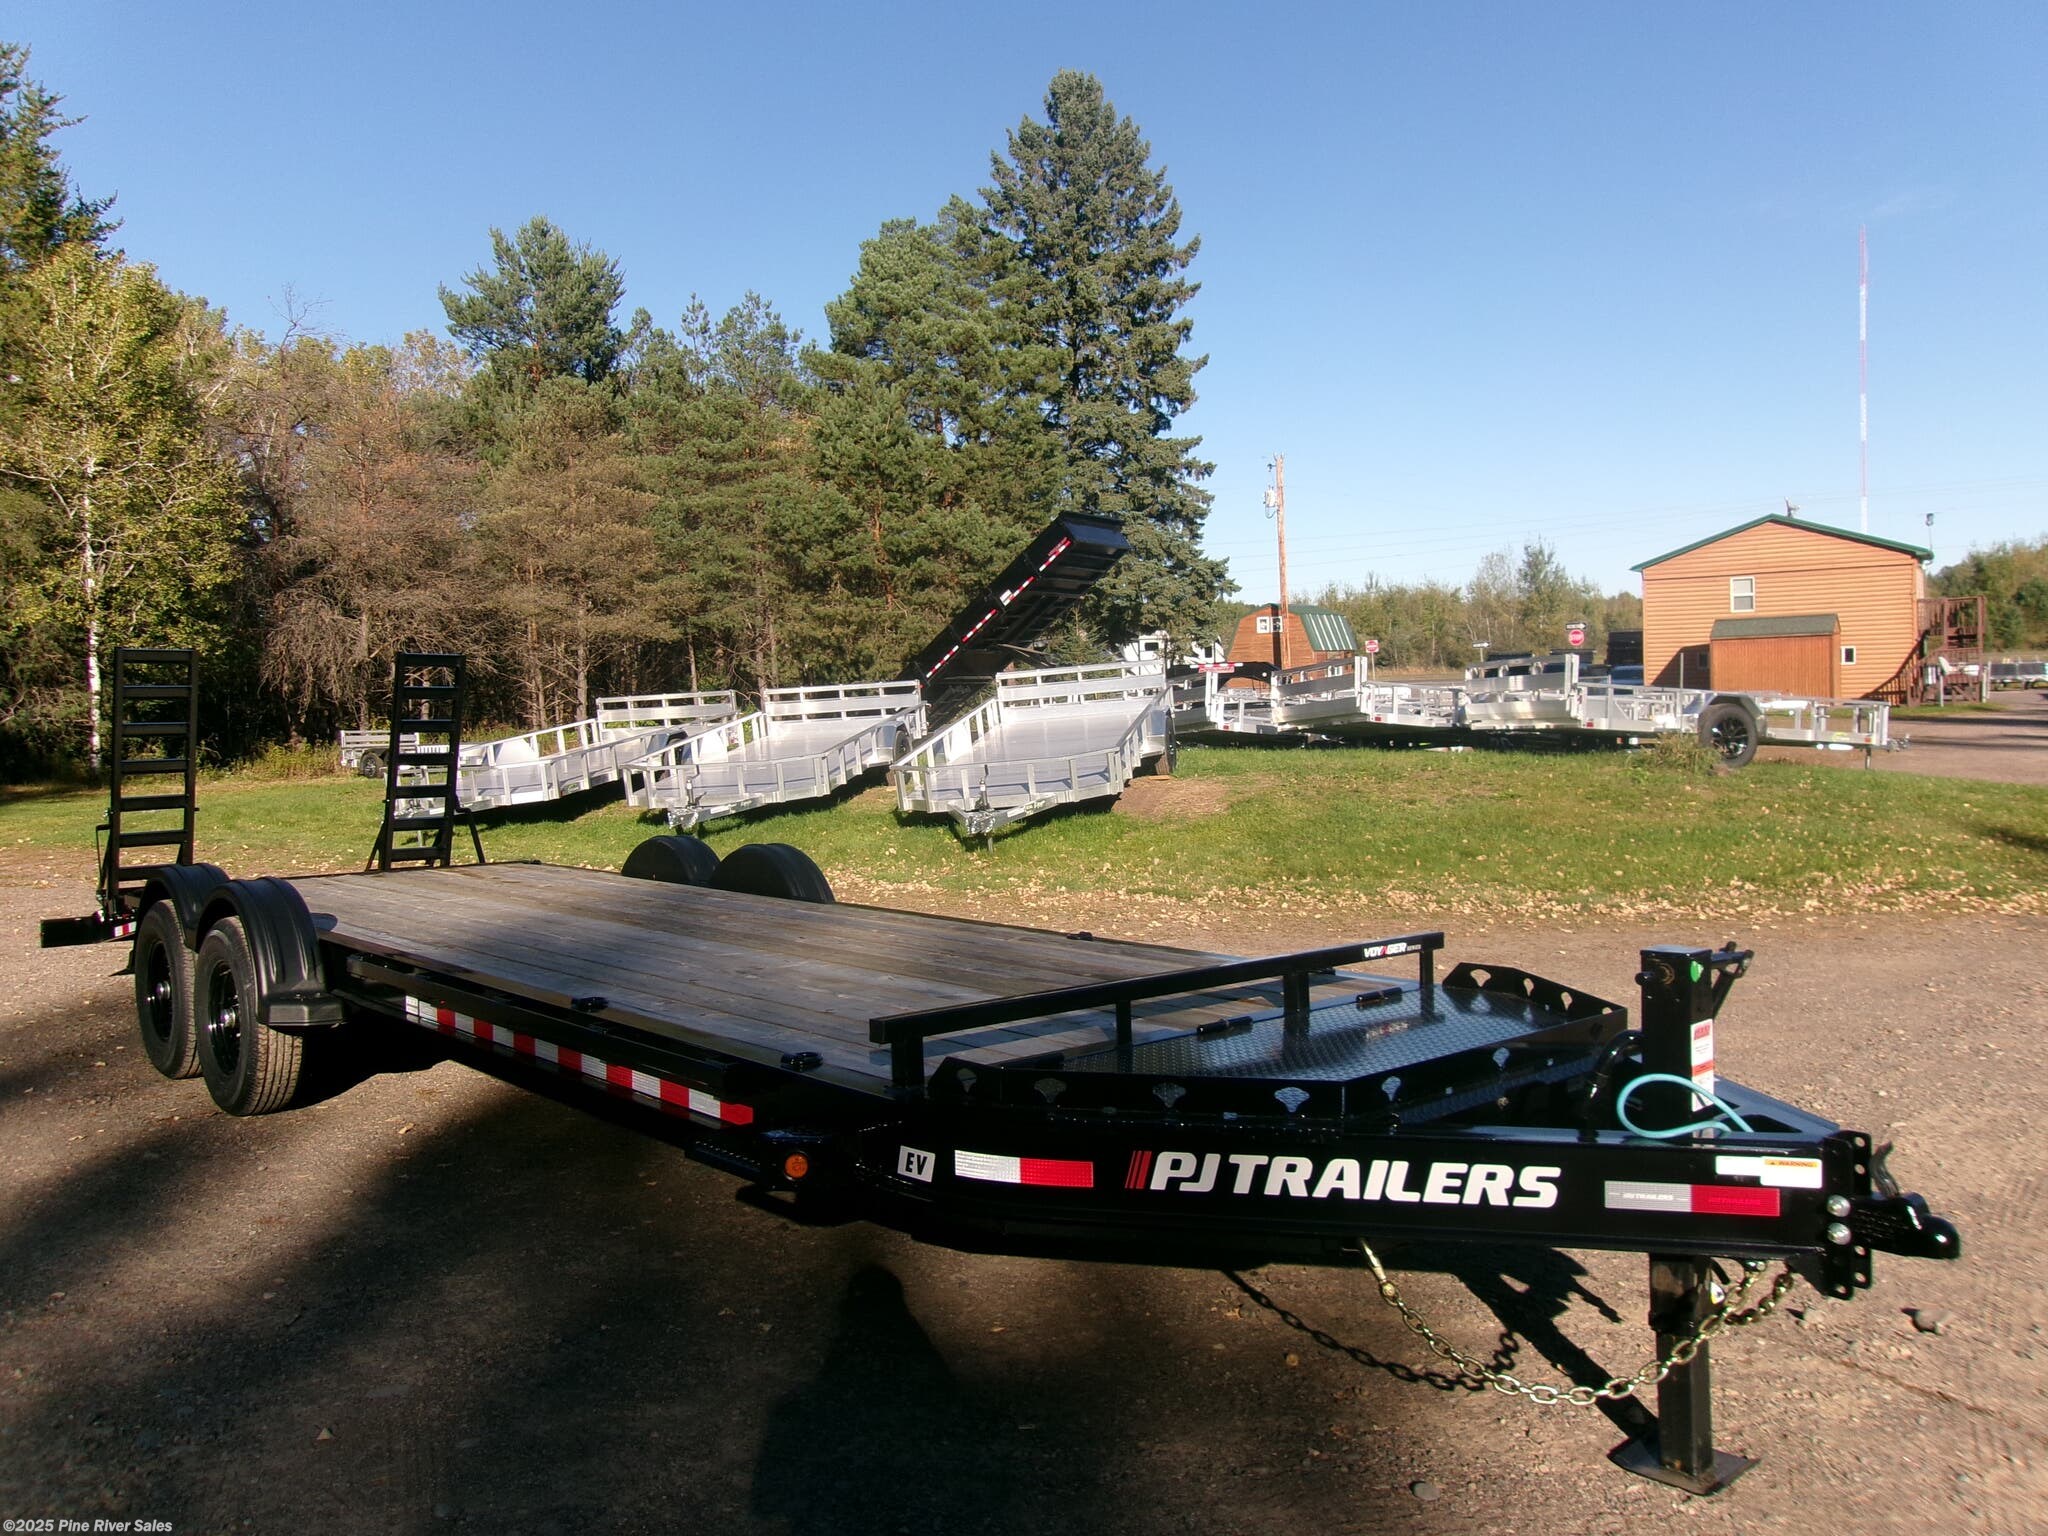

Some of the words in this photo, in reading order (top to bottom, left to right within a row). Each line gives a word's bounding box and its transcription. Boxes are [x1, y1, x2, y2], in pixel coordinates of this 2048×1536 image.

[1364, 942, 1407, 958] VOYAGER
[905, 1152, 928, 1175] EV
[1150, 1151, 1221, 1192] PJ
[1229, 1154, 1562, 1208] TRAILERS
